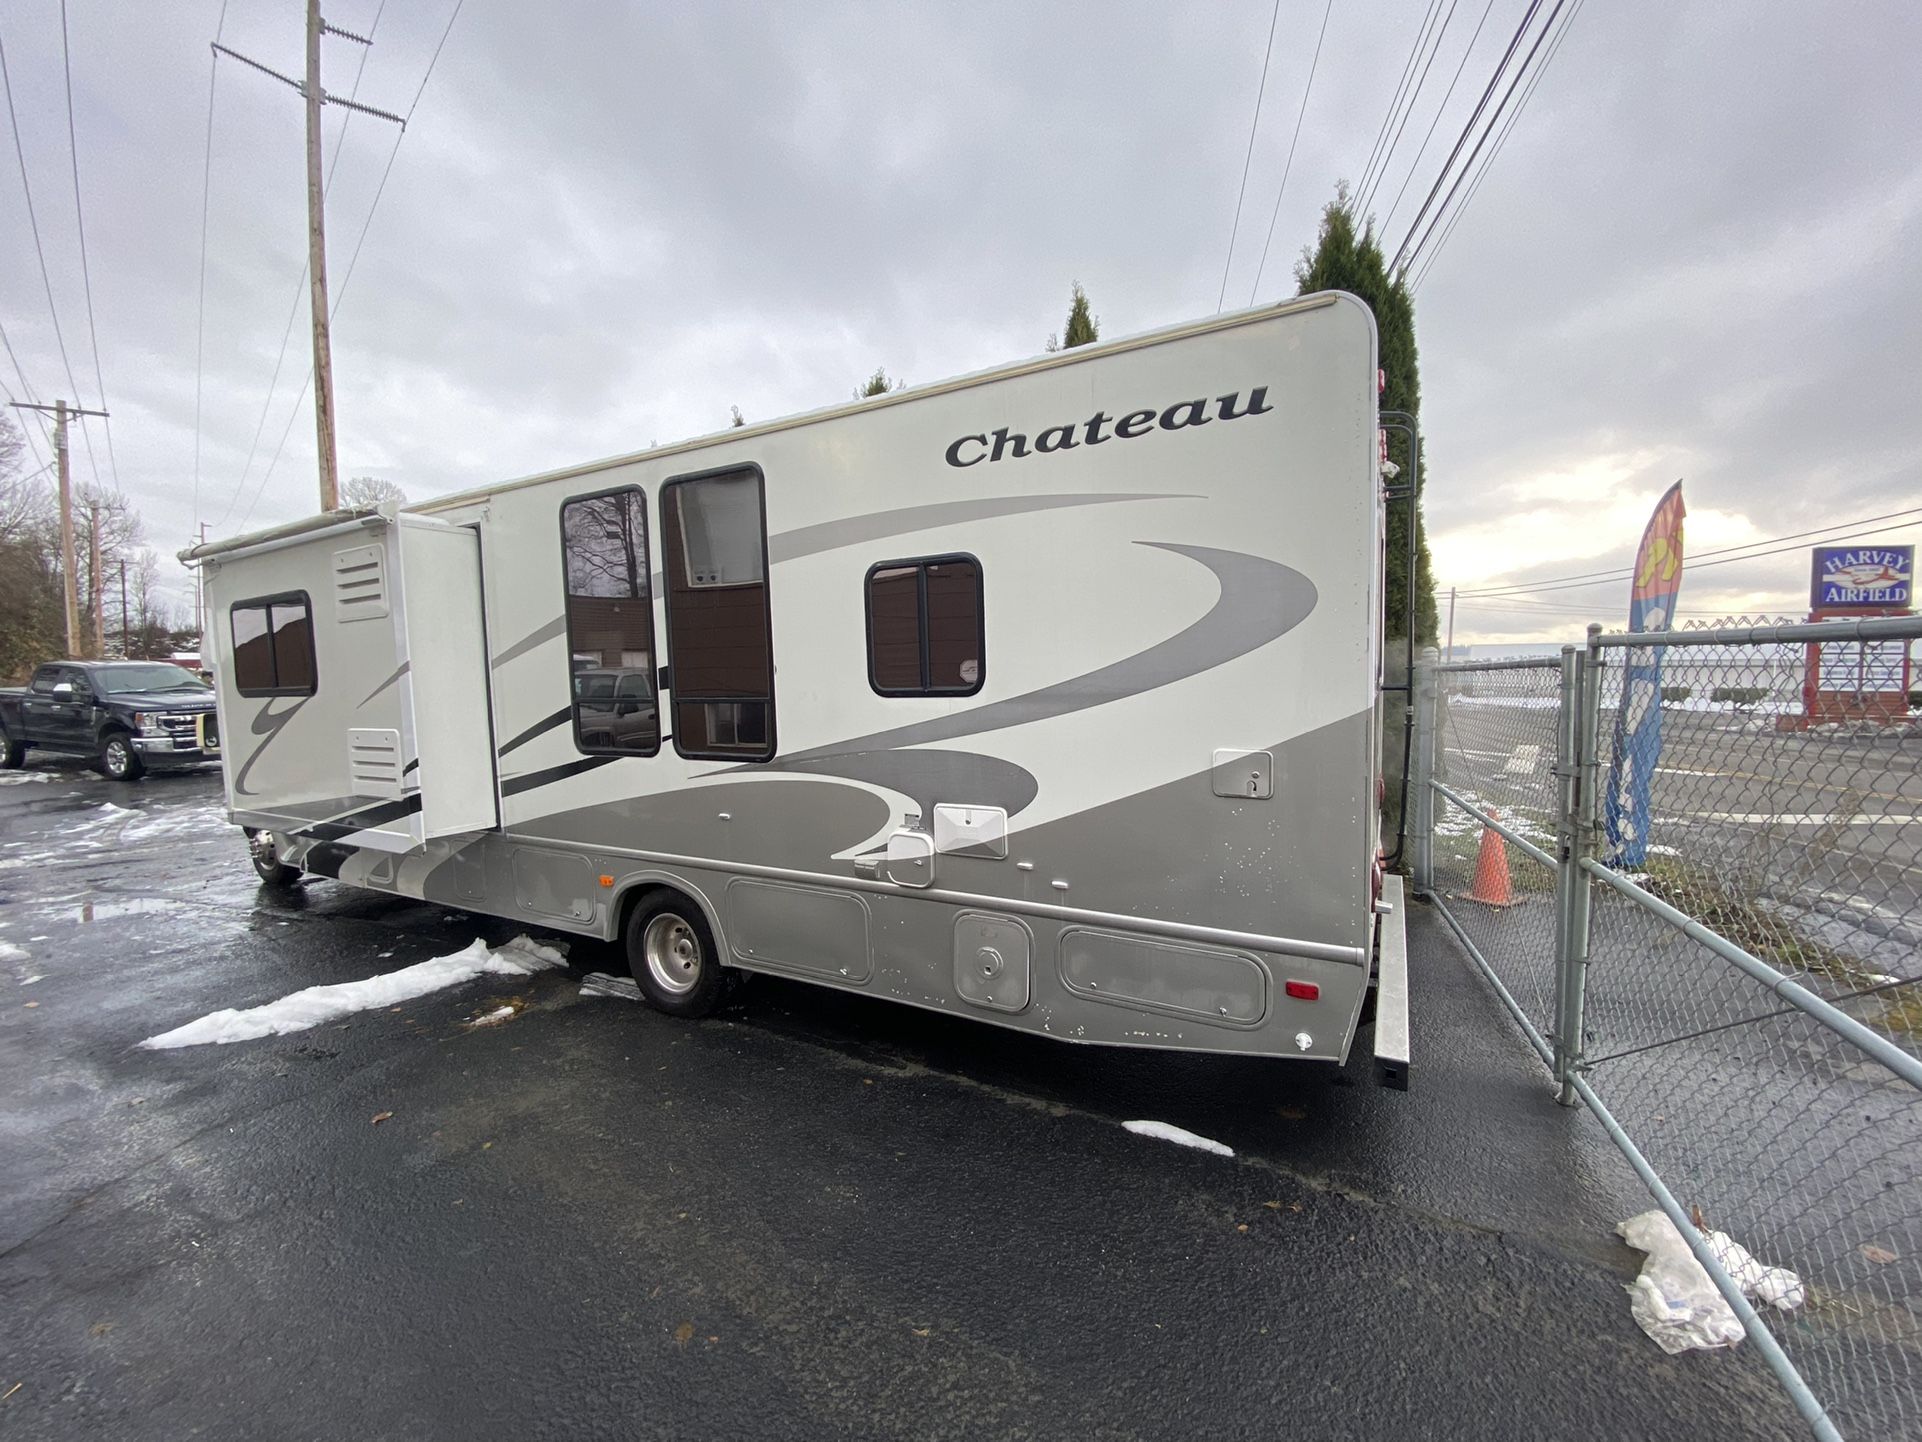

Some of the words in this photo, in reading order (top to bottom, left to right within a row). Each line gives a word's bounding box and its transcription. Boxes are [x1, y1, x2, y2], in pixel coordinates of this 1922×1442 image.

[945, 385, 1274, 468] Chateau
[1824, 550, 1909, 573] HARVEY
[1825, 587, 1907, 602] AIRFIELD
